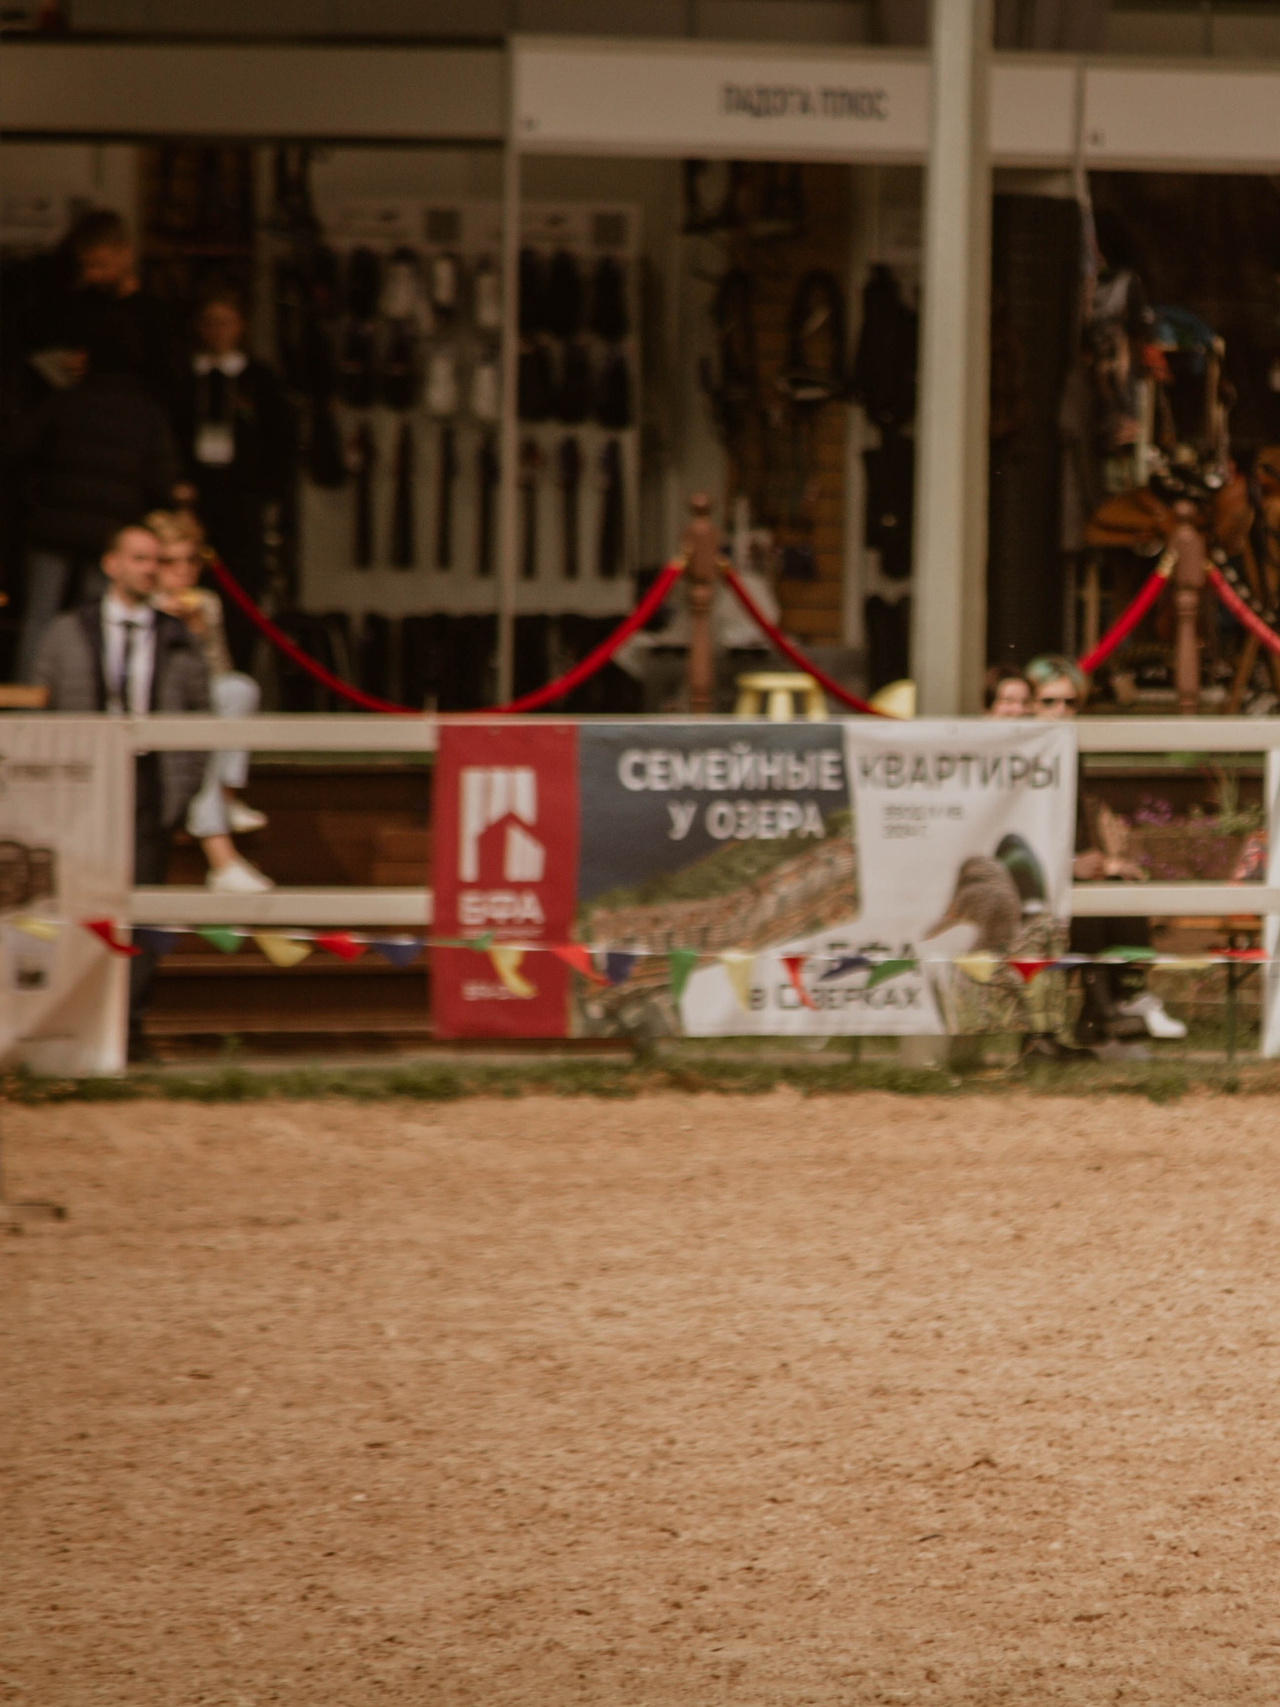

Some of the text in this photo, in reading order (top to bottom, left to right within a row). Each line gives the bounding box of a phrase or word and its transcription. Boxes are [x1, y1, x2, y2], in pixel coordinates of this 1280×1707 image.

[617, 742, 1062, 791] СЕМЕЙНЫЕ КВАРТИРЫ
[667, 801, 826, 840] У ОЗЕРА
